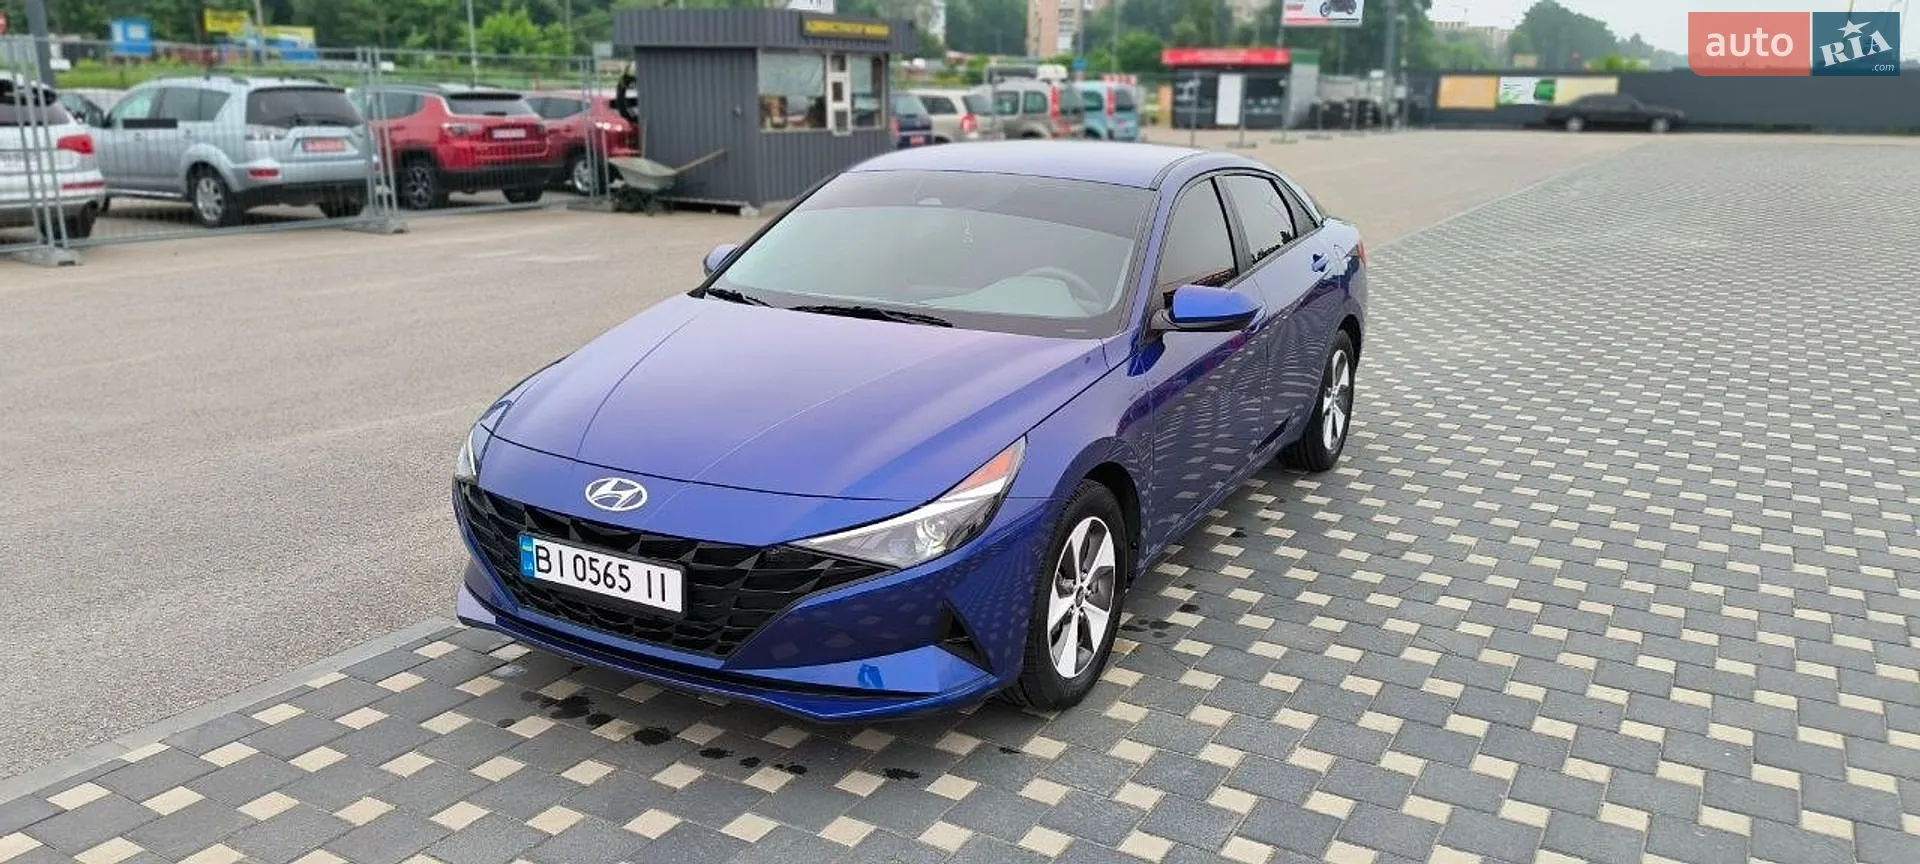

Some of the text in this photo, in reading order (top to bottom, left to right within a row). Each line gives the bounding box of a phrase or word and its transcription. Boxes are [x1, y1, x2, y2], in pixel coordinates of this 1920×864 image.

[535, 544, 667, 603] BI 0565 II
